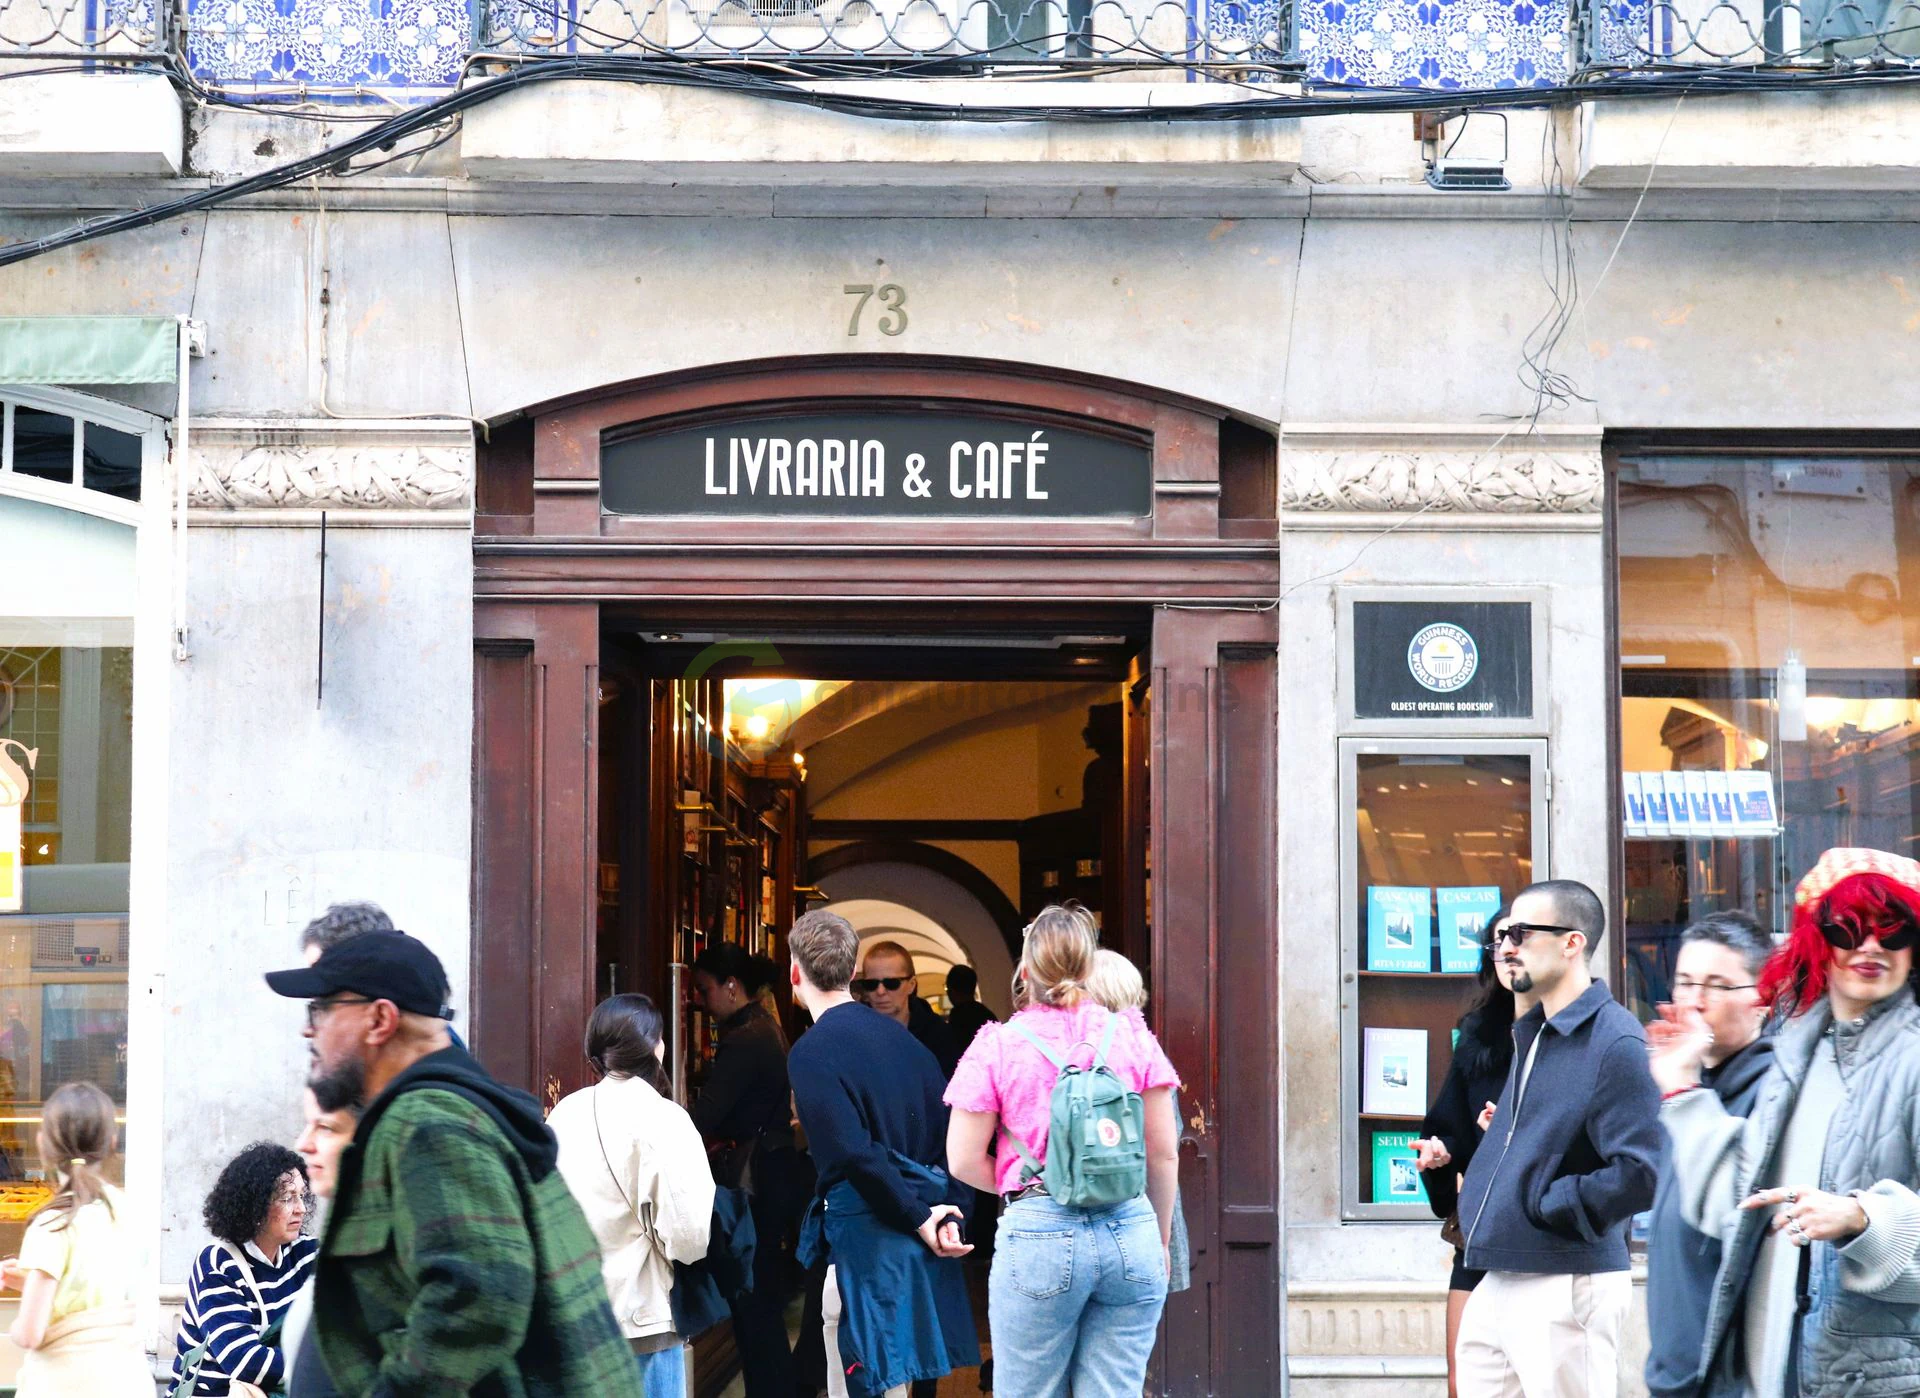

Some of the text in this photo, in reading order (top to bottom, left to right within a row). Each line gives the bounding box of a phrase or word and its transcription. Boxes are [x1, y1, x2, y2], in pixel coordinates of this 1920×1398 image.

[843, 283, 909, 337] 73
[704, 430, 1050, 500] LIVRARIA & CAFÉ
[1417, 626, 1468, 646] GUINNESS
[1411, 652, 1474, 689] WORLD RECORDS
[1391, 701, 1494, 711] OLDEST OPERATING BOOKSHOP
[1374, 891, 1426, 902] CASCAIS
[1442, 891, 1496, 903] CASCAIS
